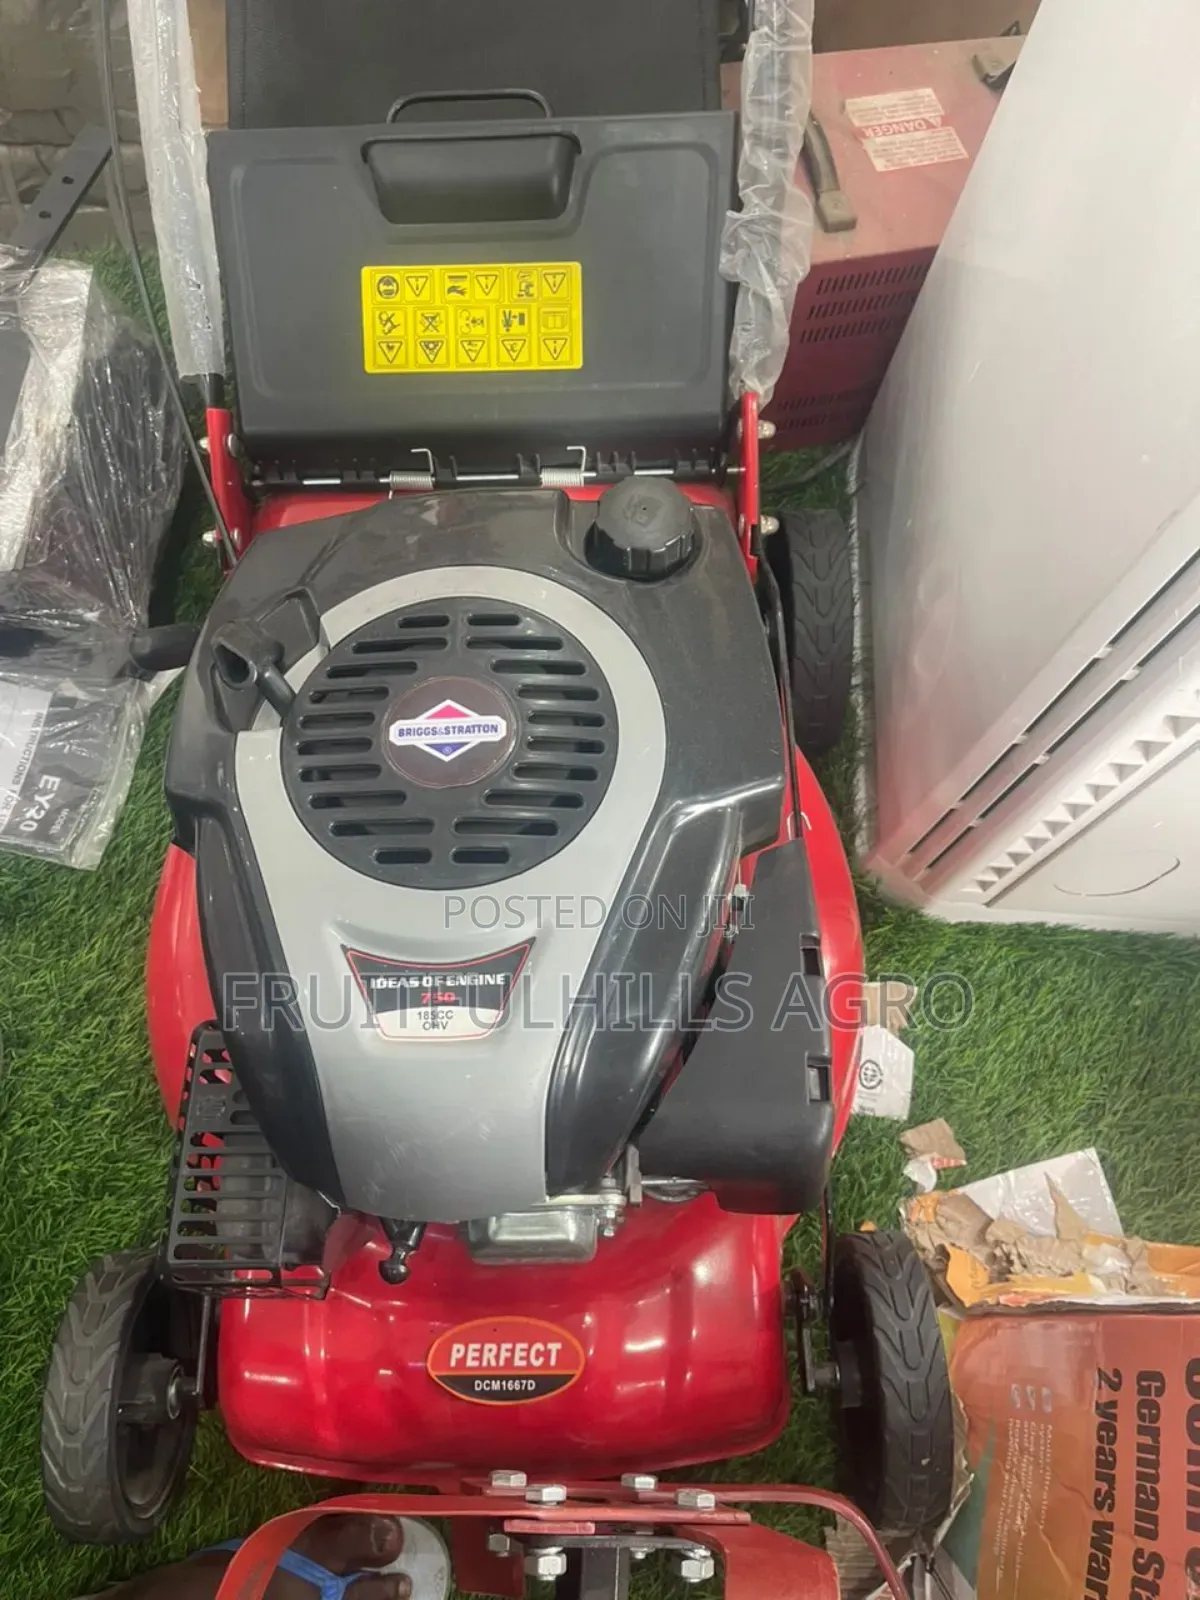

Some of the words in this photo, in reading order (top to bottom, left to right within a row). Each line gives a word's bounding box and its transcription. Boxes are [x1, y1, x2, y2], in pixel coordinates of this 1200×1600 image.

[861, 119, 927, 137] DANGER
[11, 712, 44, 786] INSTRUCTIONS
[370, 975, 419, 989] IDEAS
[446, 973, 506, 987] ENGINE
[450, 1342, 562, 1367] PERFECT
[474, 1379, 536, 1391] DCM1667D
[1097, 1367, 1123, 1392] 2
[1093, 1399, 1118, 1513] years
[1133, 1370, 1166, 1541] German
